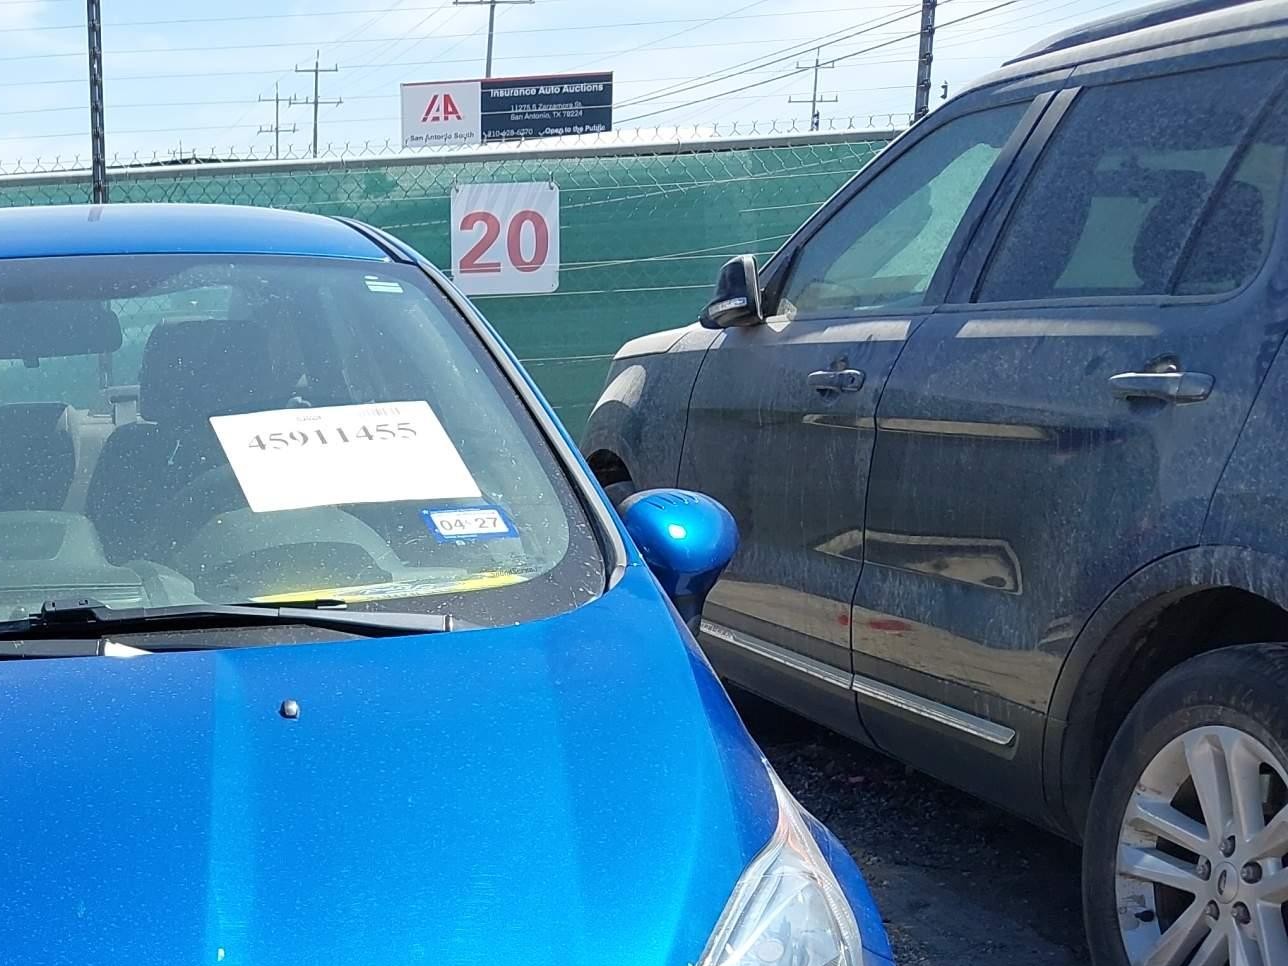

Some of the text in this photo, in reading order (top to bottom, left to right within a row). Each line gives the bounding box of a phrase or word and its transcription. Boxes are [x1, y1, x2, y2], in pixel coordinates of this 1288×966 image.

[490, 83, 604, 97] Insurance Auto Auctions
[545, 126, 563, 135] Open
[573, 125, 583, 133] the
[459, 209, 549, 274] 20
[248, 422, 416, 450] 45911455
